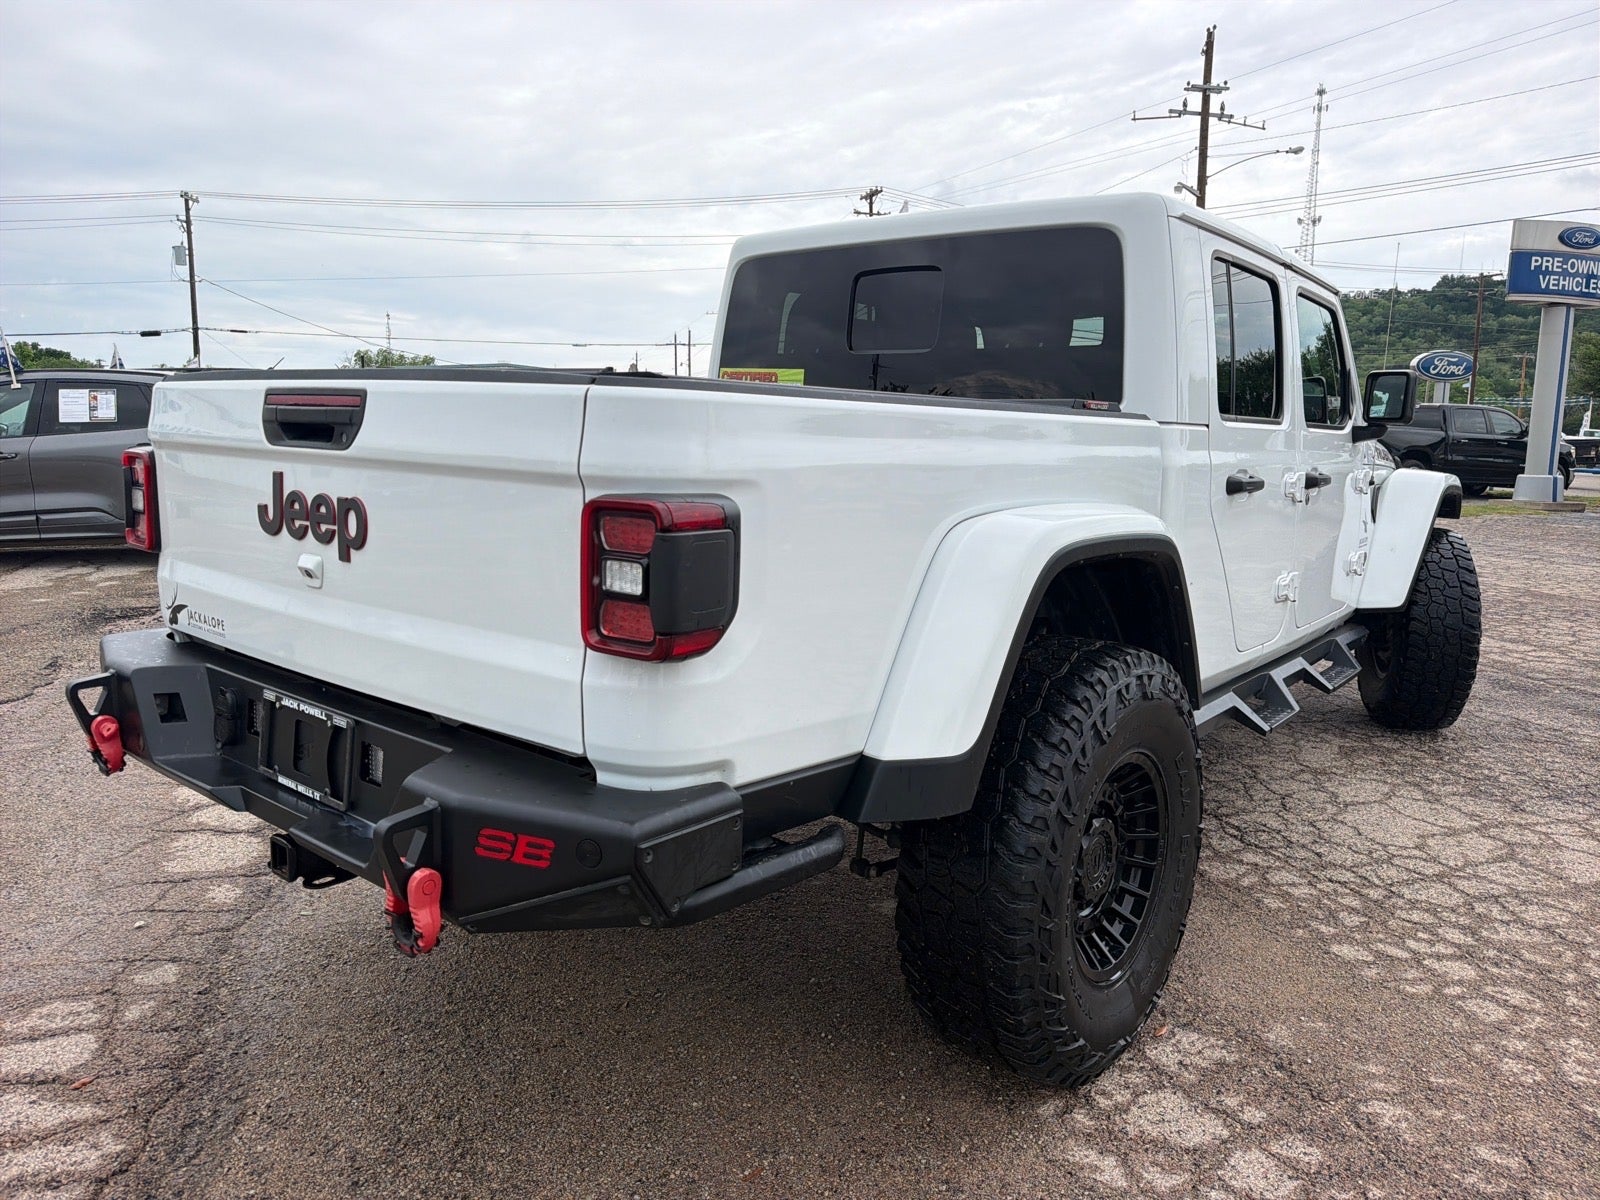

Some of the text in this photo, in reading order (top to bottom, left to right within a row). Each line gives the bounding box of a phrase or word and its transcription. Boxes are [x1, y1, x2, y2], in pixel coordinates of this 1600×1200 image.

[1571, 231, 1597, 244] Ford
[1531, 256, 1600, 276] PRE-OWN
[1429, 356, 1467, 375] Ford
[257, 471, 368, 563] Jeep
[187, 608, 225, 631] JACKALOPE
[281, 697, 327, 720] JACK POWELL
[474, 827, 556, 870] SB
